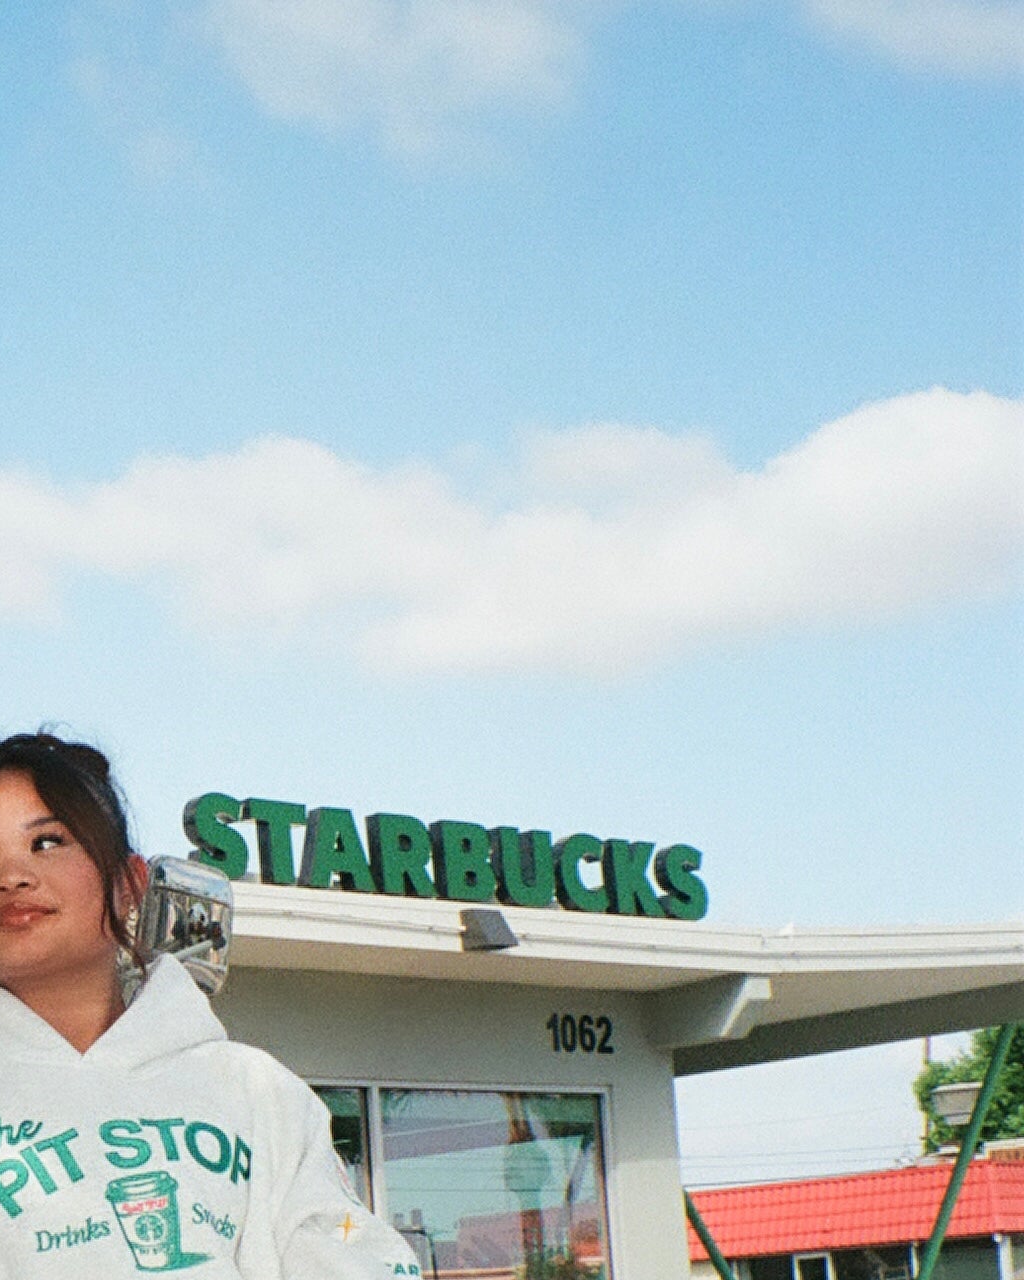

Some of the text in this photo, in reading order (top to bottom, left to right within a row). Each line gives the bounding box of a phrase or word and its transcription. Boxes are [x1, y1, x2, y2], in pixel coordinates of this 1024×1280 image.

[183, 792, 709, 921] STARBUCKS
[546, 1013, 614, 1054] 1062
[98, 1117, 252, 1185] STOP
[34, 1217, 112, 1253] Drinks
